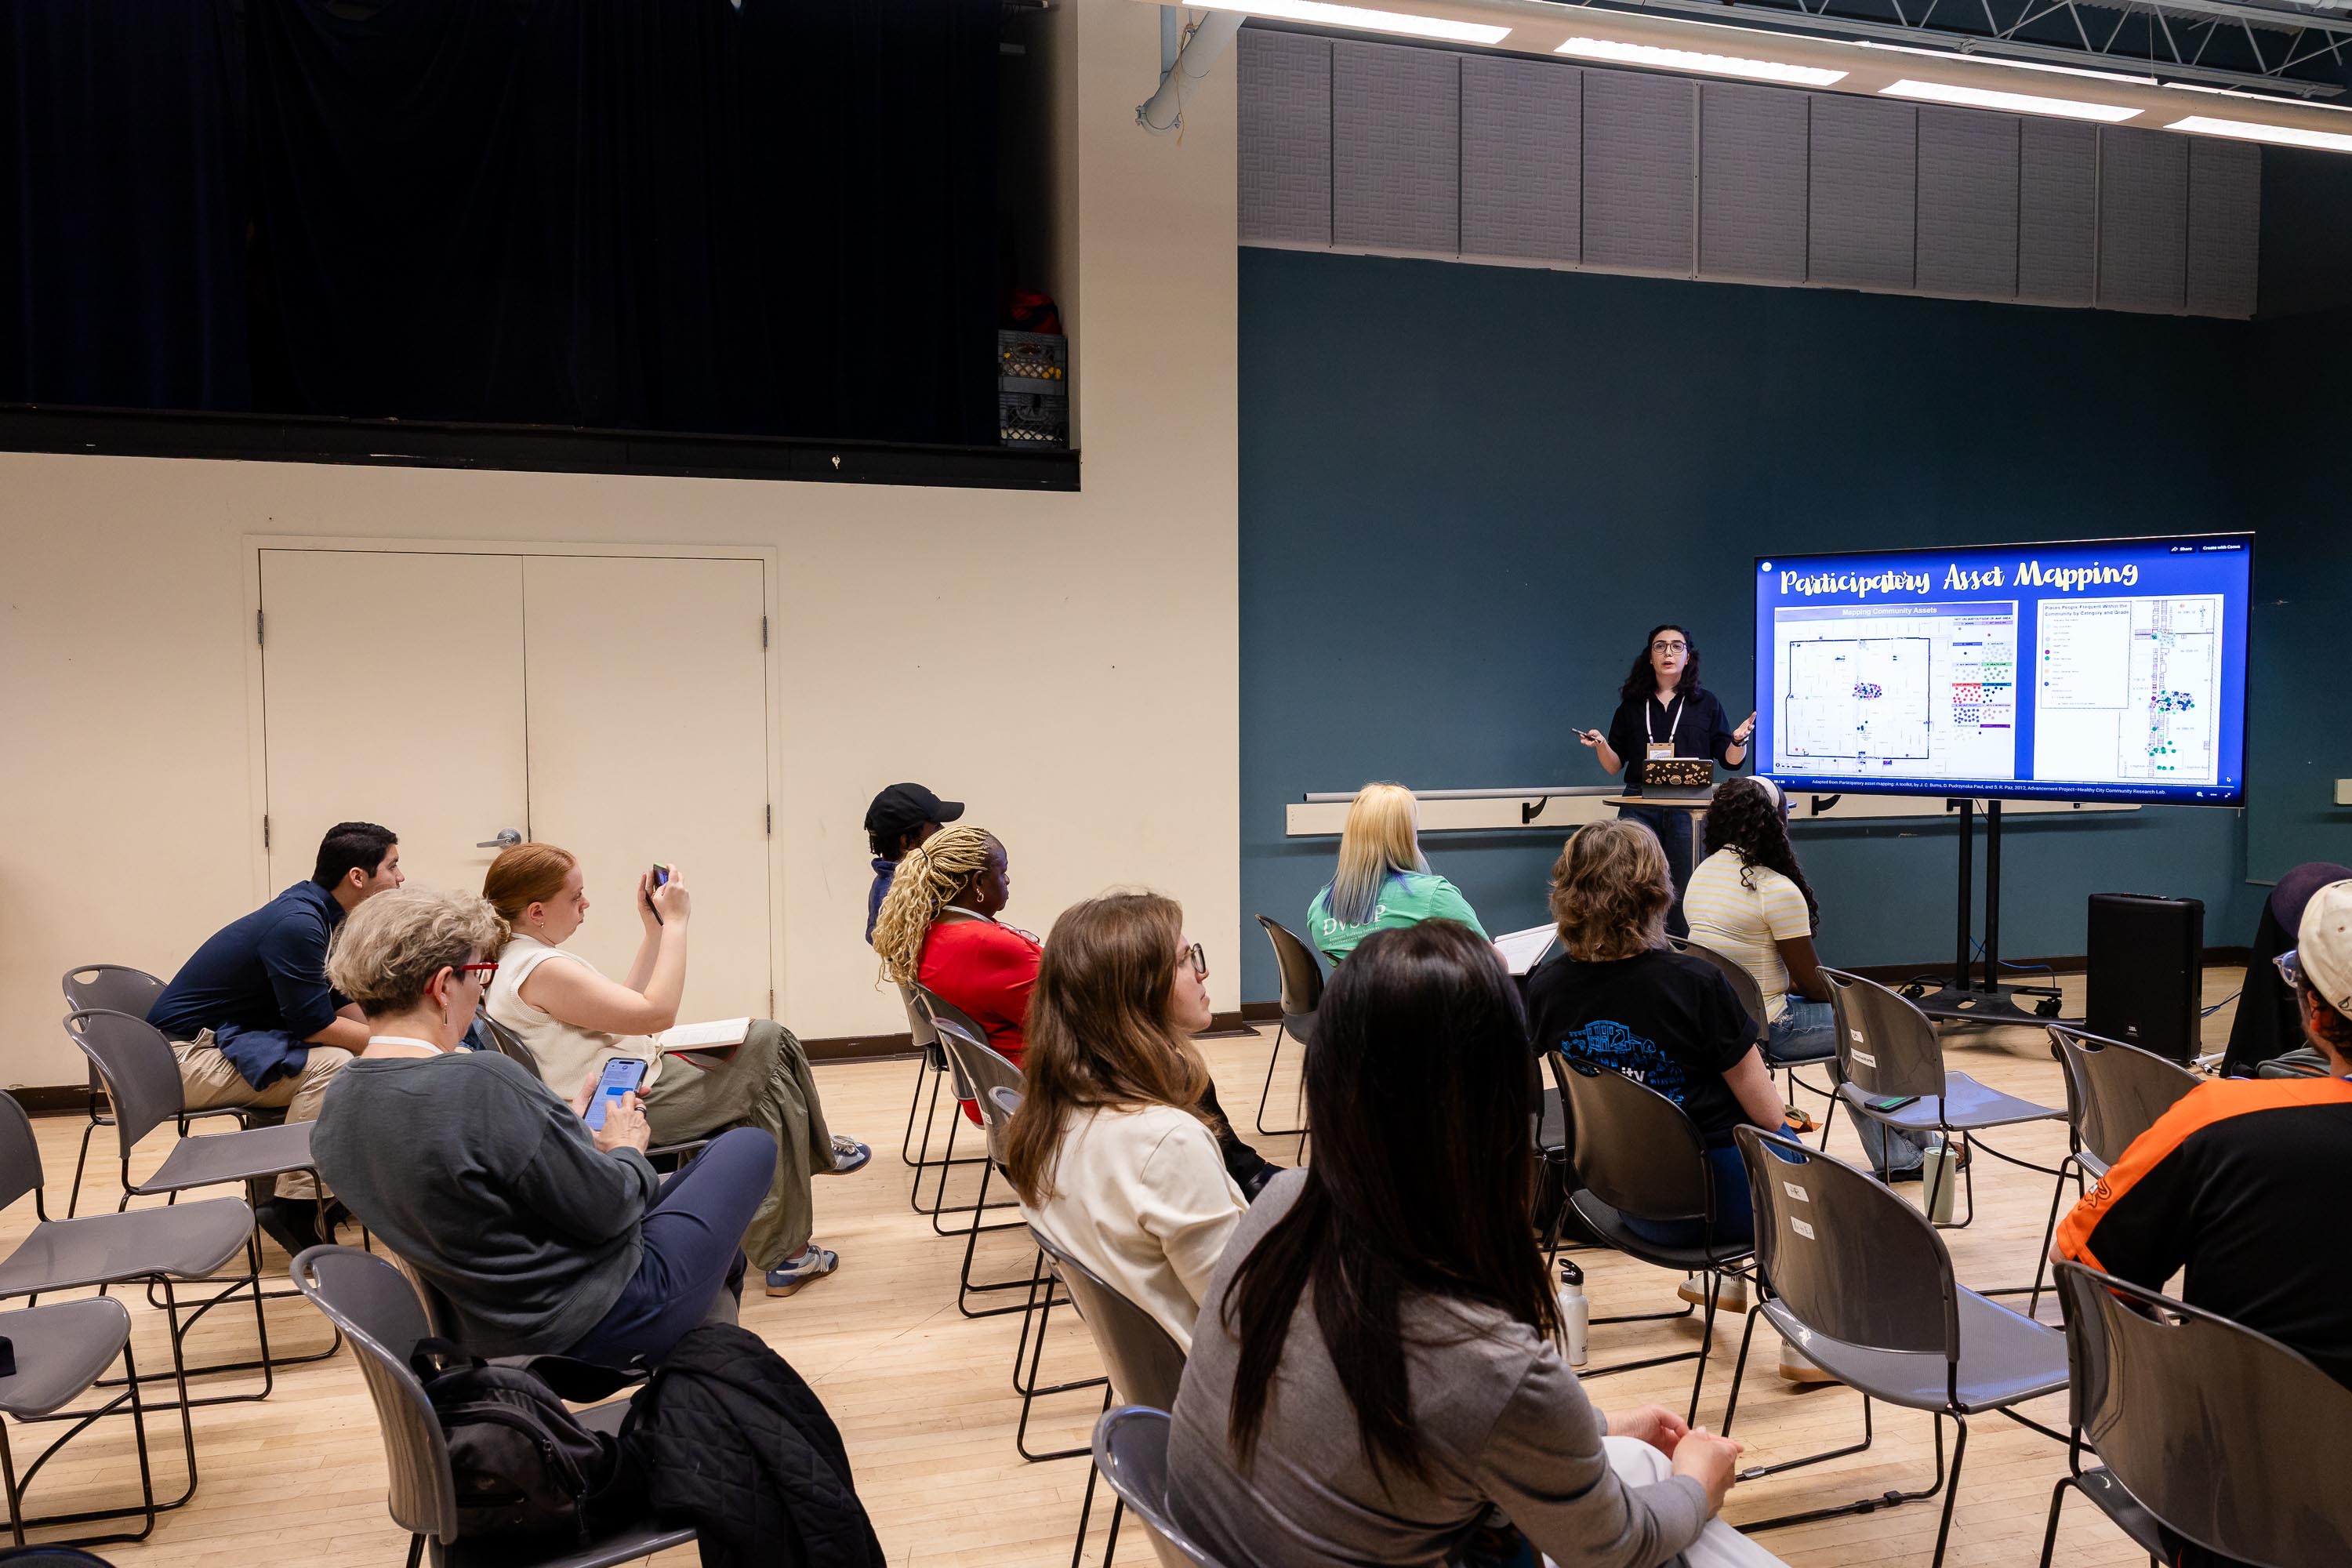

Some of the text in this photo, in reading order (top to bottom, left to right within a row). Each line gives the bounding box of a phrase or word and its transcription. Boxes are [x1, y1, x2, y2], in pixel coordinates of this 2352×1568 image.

[1780, 560, 2139, 598] Participatory Asset Mapping
[1323, 904, 1386, 937] DVP
